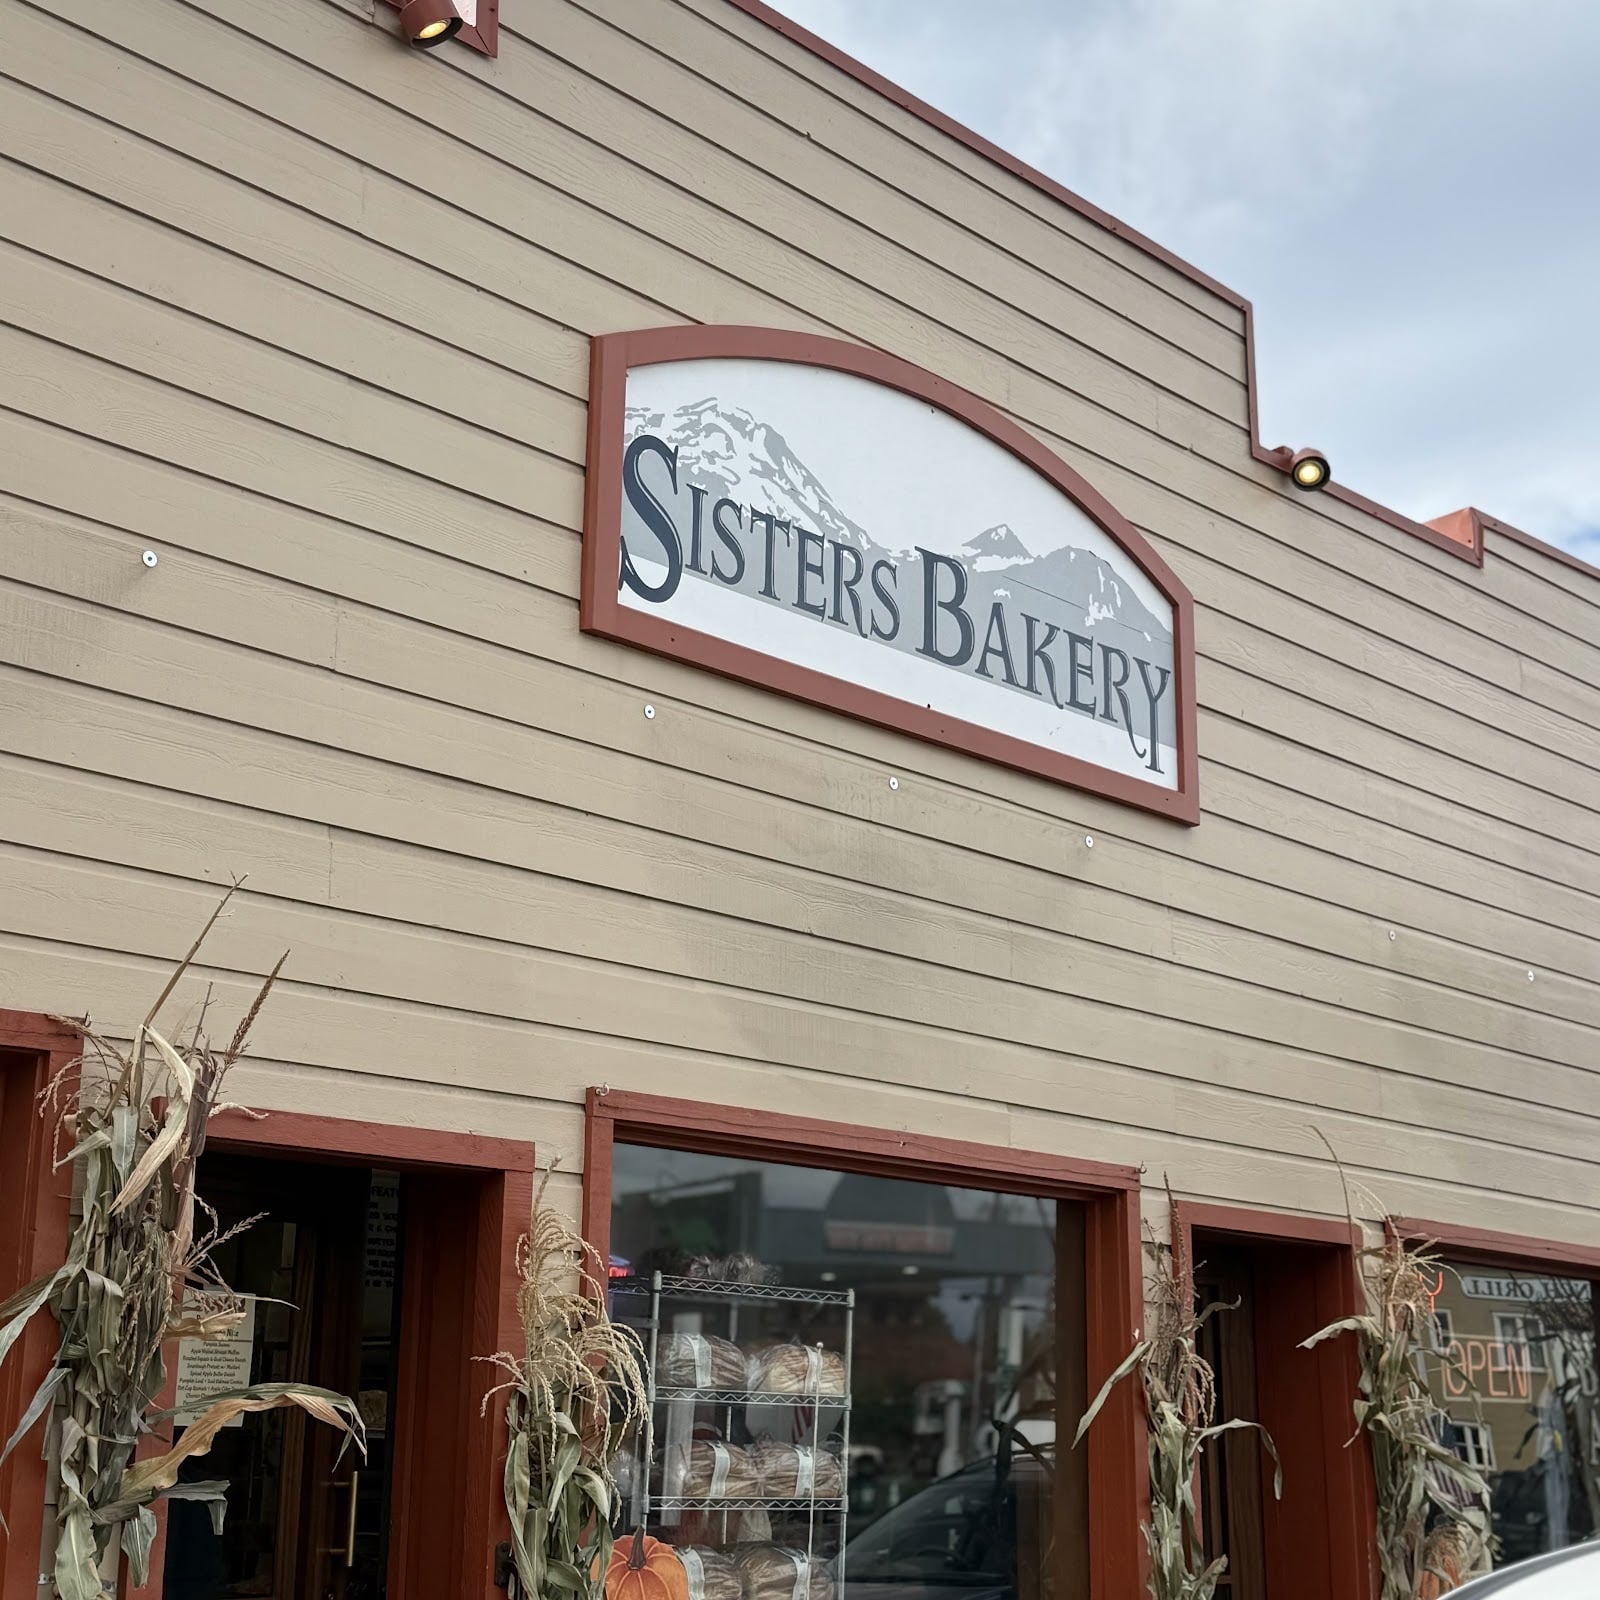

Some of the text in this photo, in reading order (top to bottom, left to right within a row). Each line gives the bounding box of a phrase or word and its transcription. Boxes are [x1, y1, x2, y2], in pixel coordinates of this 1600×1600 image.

[619, 434, 1171, 775] SISTERS BAKERY
[1446, 1340, 1528, 1397] OPEN
